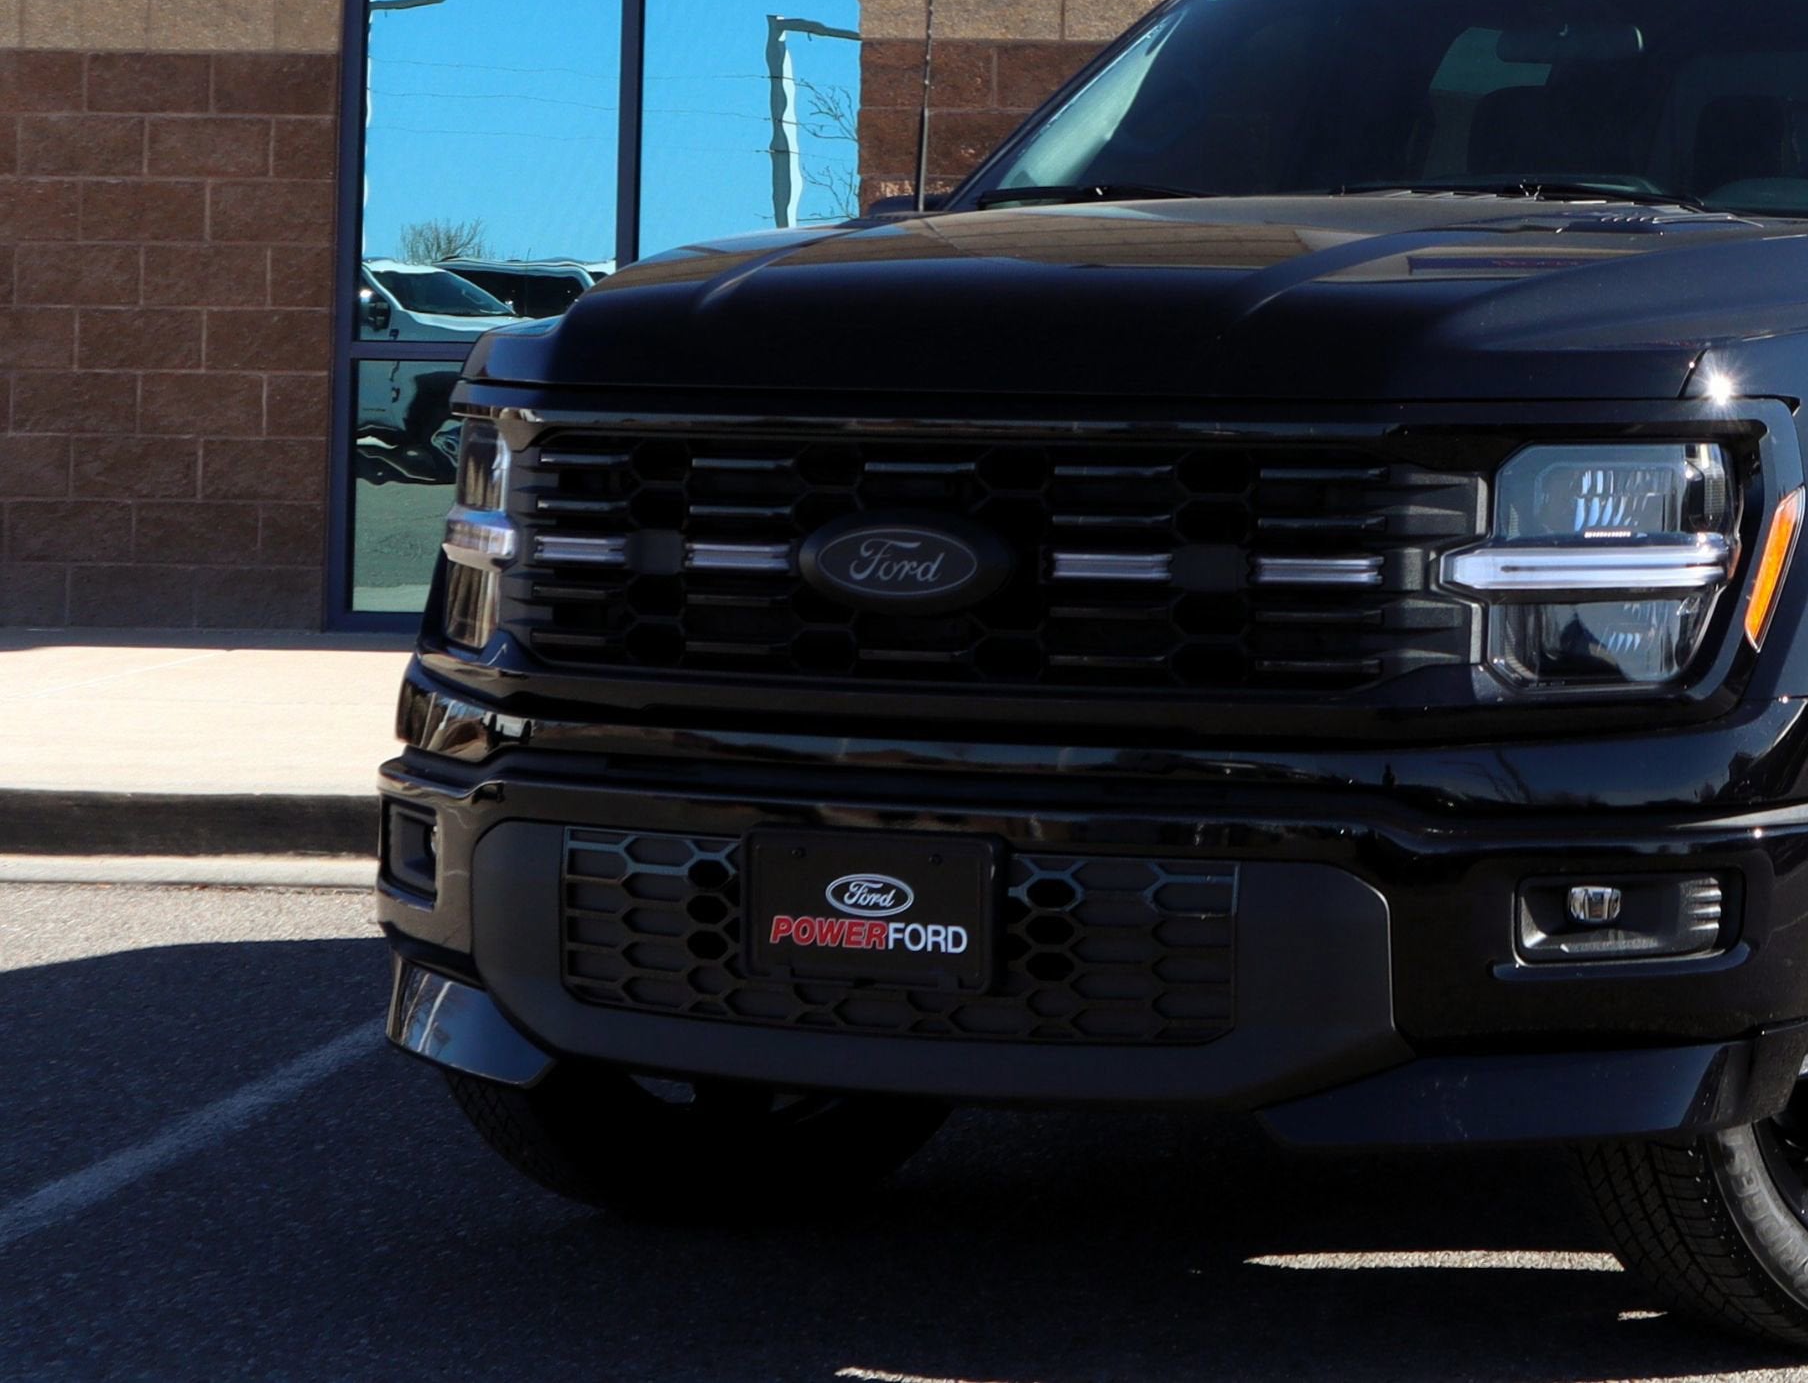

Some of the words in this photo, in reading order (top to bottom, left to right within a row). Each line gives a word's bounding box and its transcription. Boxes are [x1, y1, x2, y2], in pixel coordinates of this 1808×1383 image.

[849, 537, 945, 583] Ford
[843, 880, 897, 908] Ford
[769, 914, 969, 954] POWERFORD
